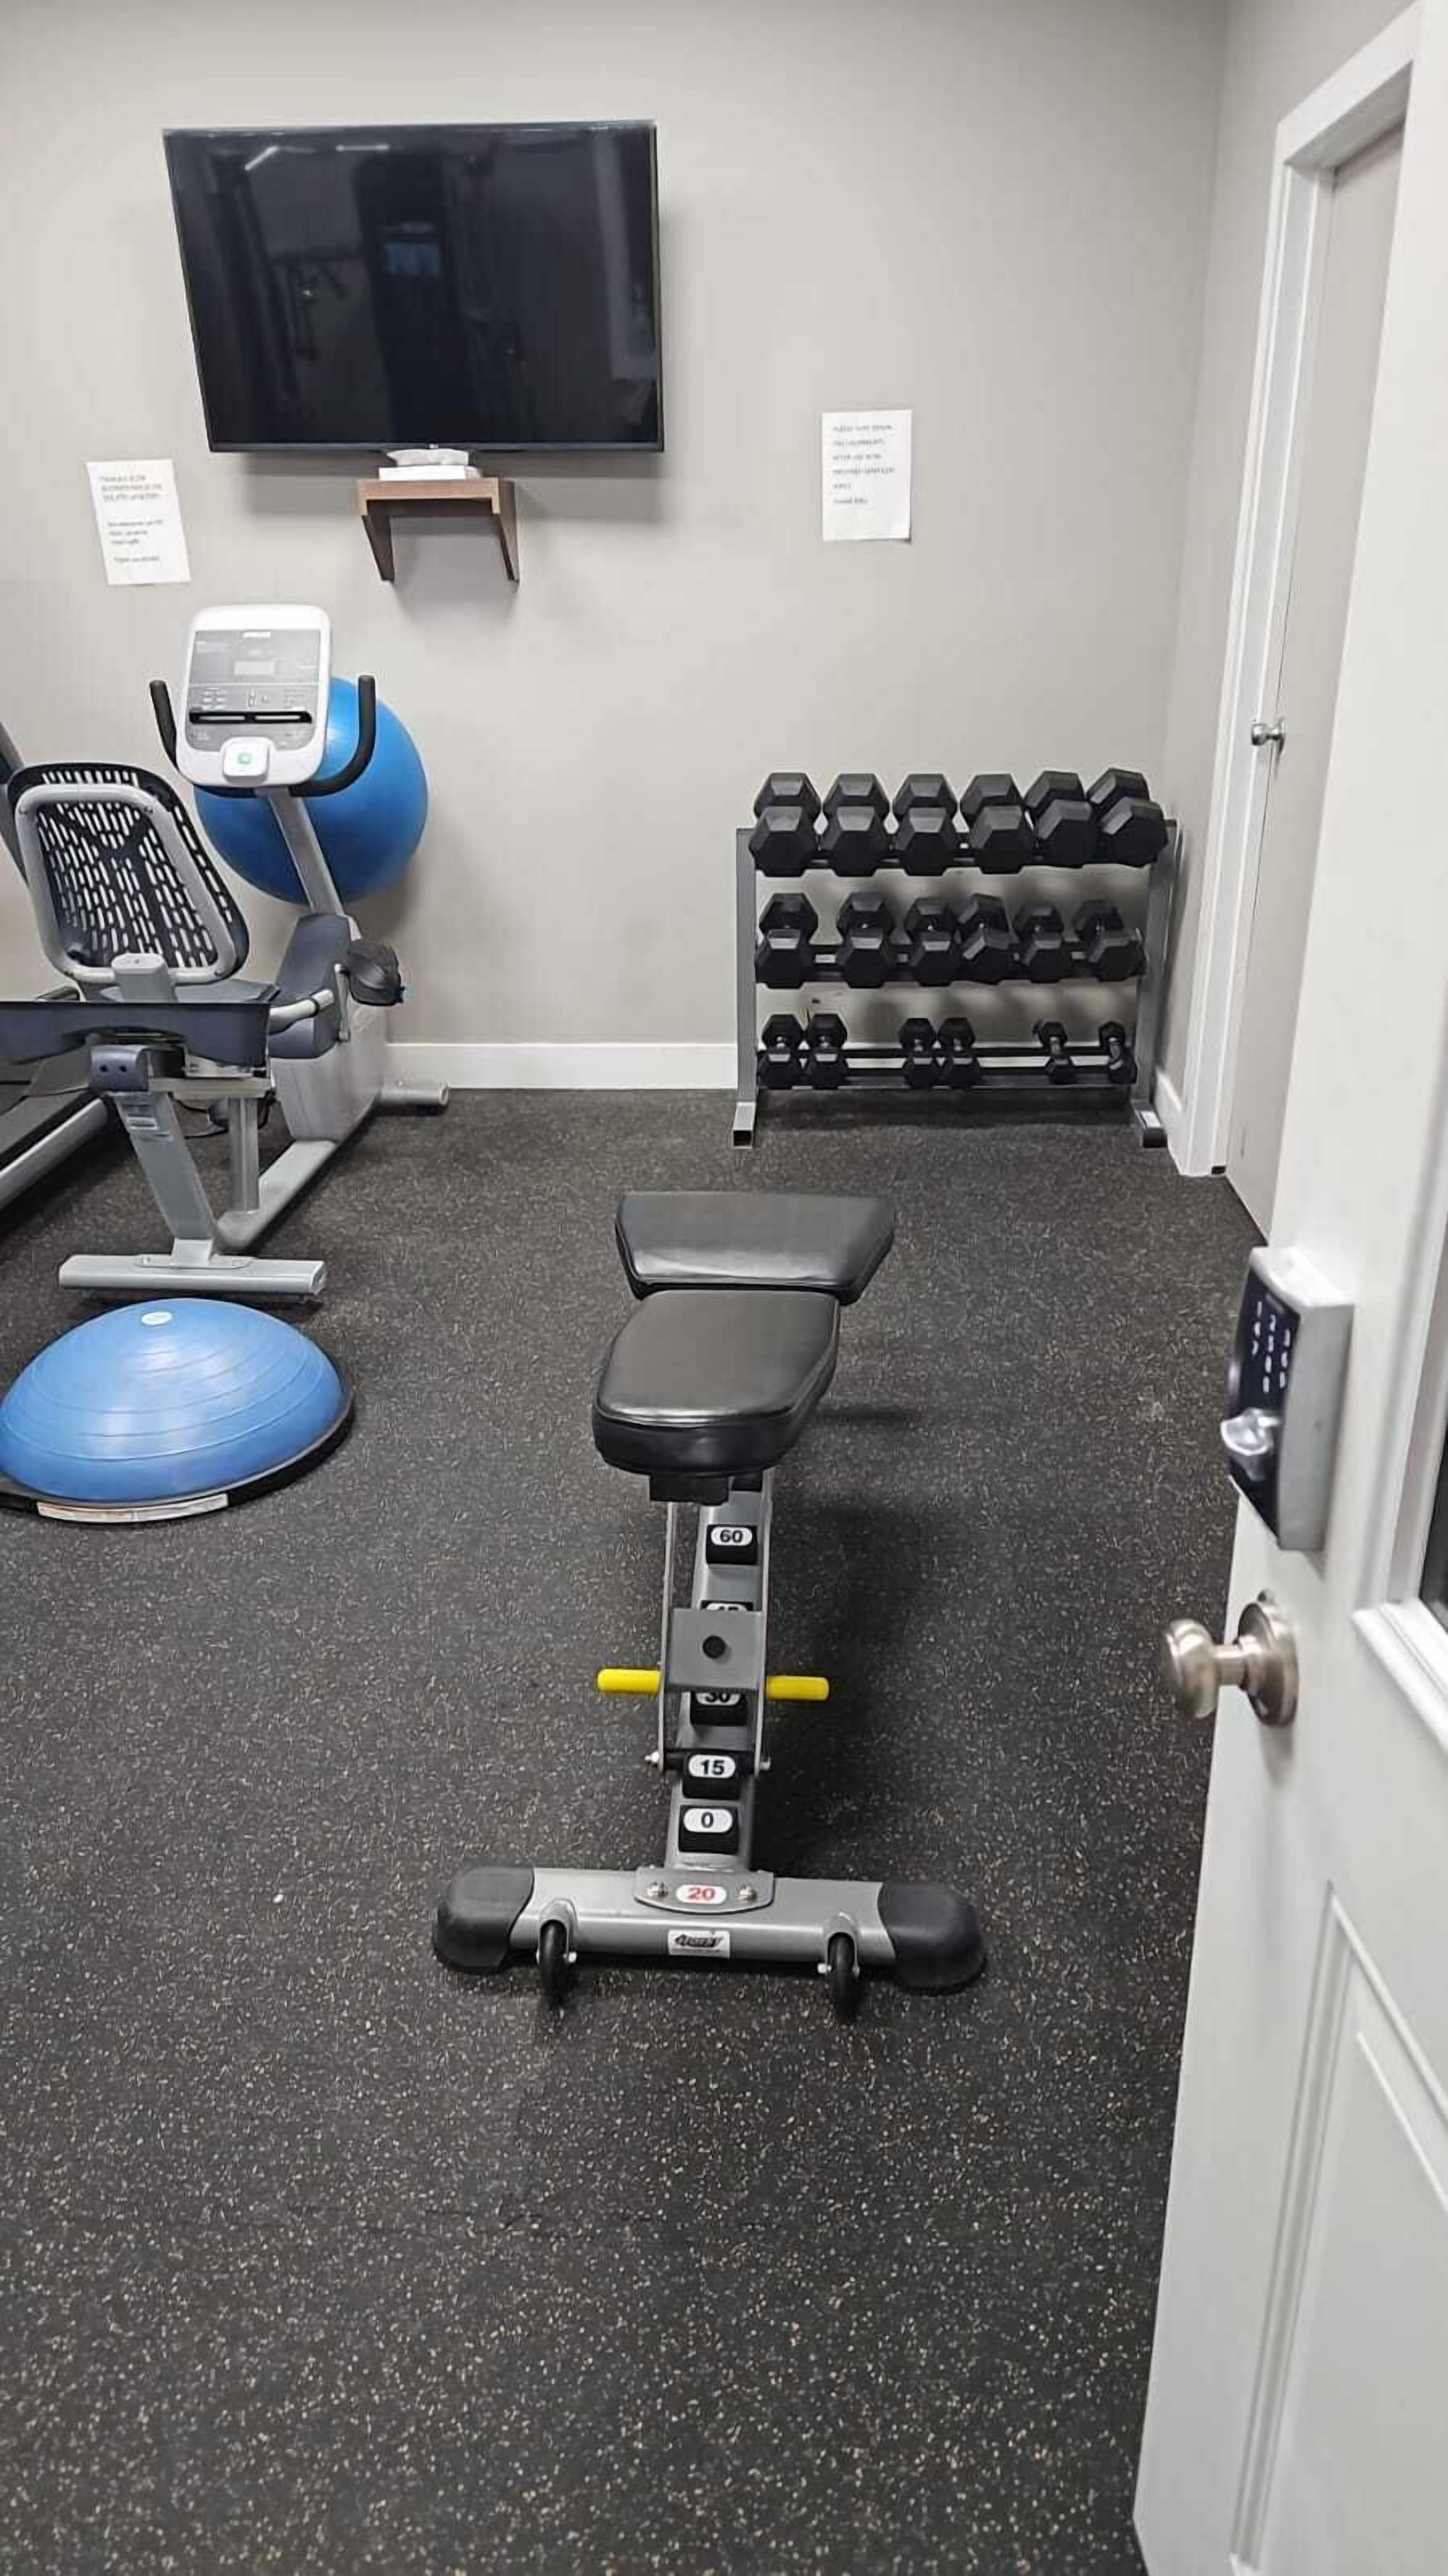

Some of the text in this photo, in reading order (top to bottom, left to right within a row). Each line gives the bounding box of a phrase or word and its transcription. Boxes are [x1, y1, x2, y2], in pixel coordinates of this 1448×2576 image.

[720, 1529, 743, 1543] 60
[705, 1692, 731, 1703] 30
[700, 1759, 724, 1775] 15
[701, 1812, 714, 1828] 0
[687, 1887, 716, 1901] 20
